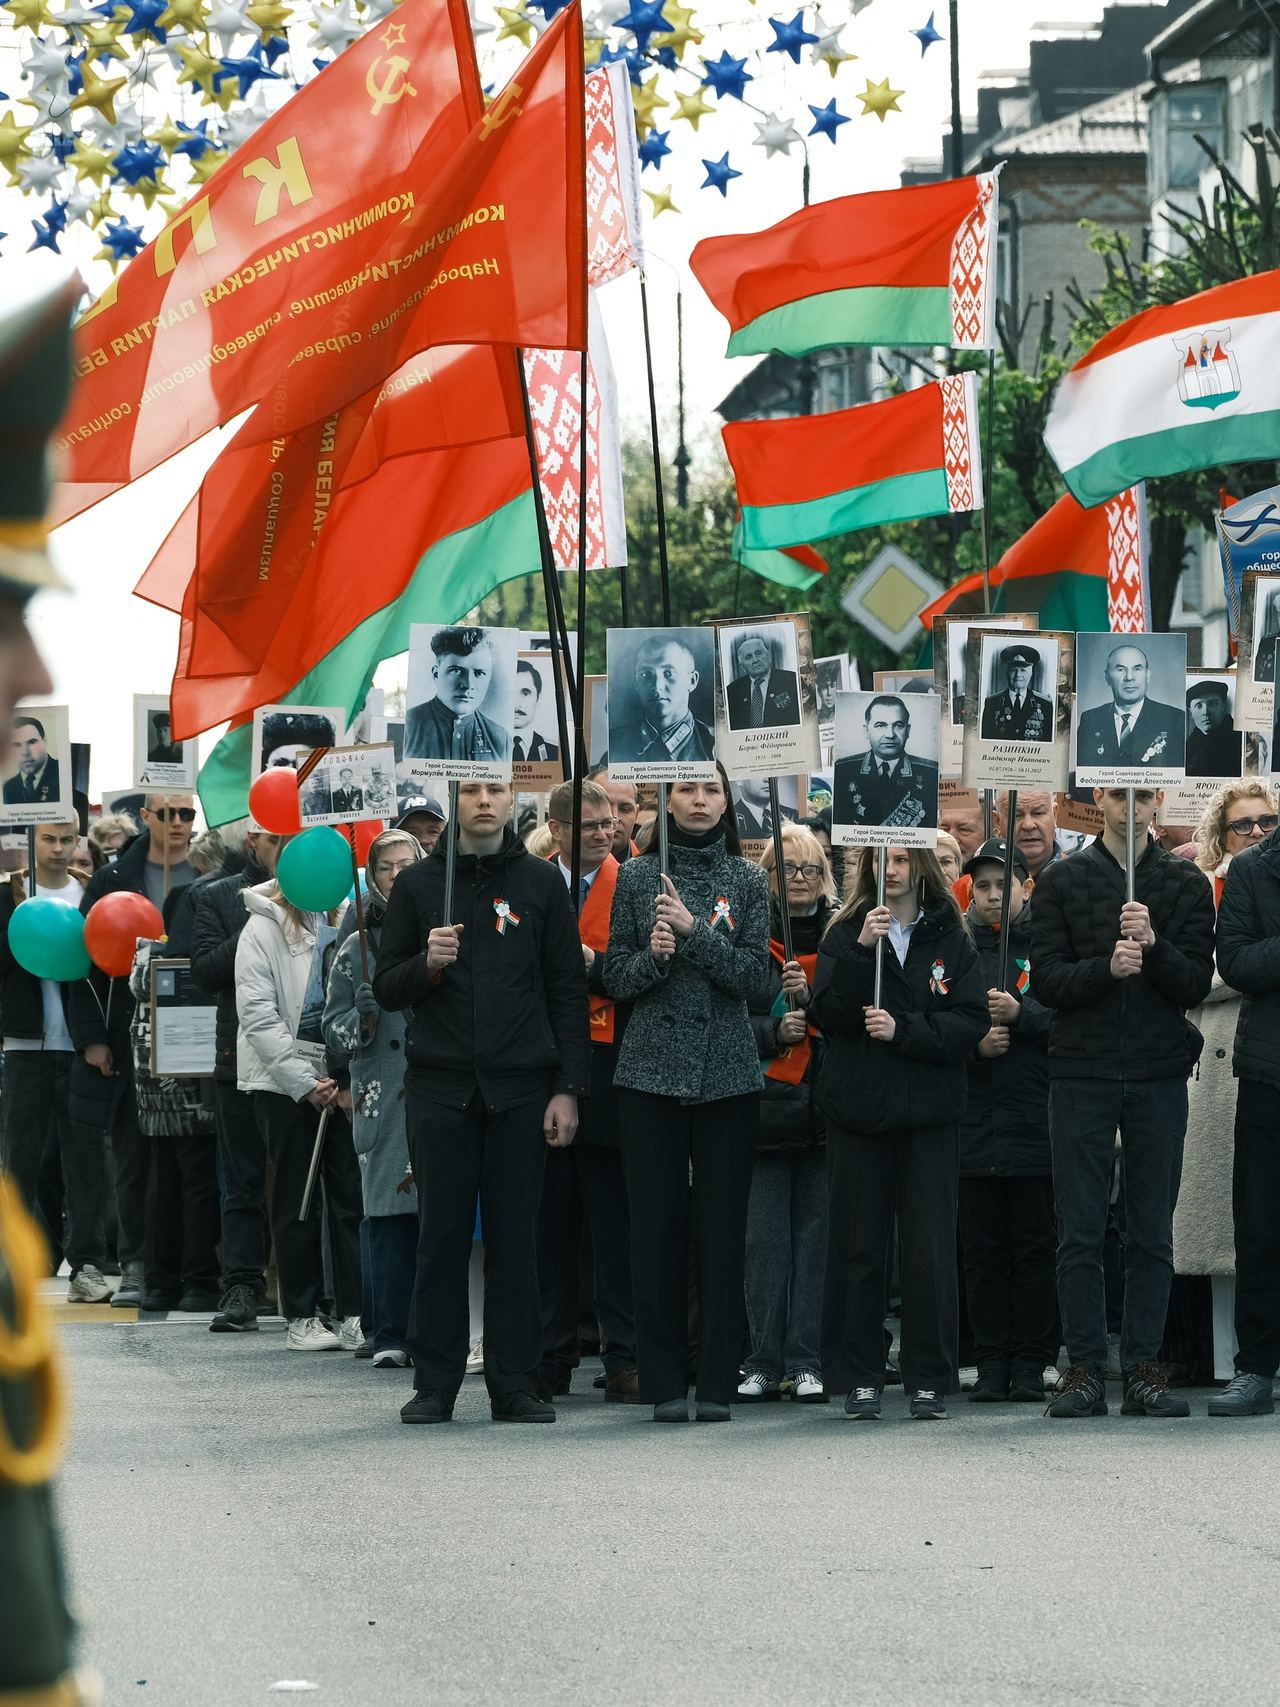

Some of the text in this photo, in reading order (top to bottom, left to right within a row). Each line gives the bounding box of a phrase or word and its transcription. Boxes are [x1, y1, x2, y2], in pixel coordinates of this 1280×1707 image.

[744, 730, 789, 743] БЛОЦКИЙ
[738, 741, 797, 752] Борис Фёдорович
[992, 745, 1041, 755] РАЗИНКИН
[982, 754, 1051, 764] Владимир Иванович
[425, 762, 441, 770] Герой
[442, 762, 472, 770] Советского
[411, 769, 503, 780] Мормулёв Михаил Глебович
[677, 772, 714, 780] Ефремович
[1080, 777, 1182, 785] Федоренко Степан Алексеевич
[870, 829, 898, 837] Советского
[842, 836, 927, 846] Крейзер Яков Григорьевич
